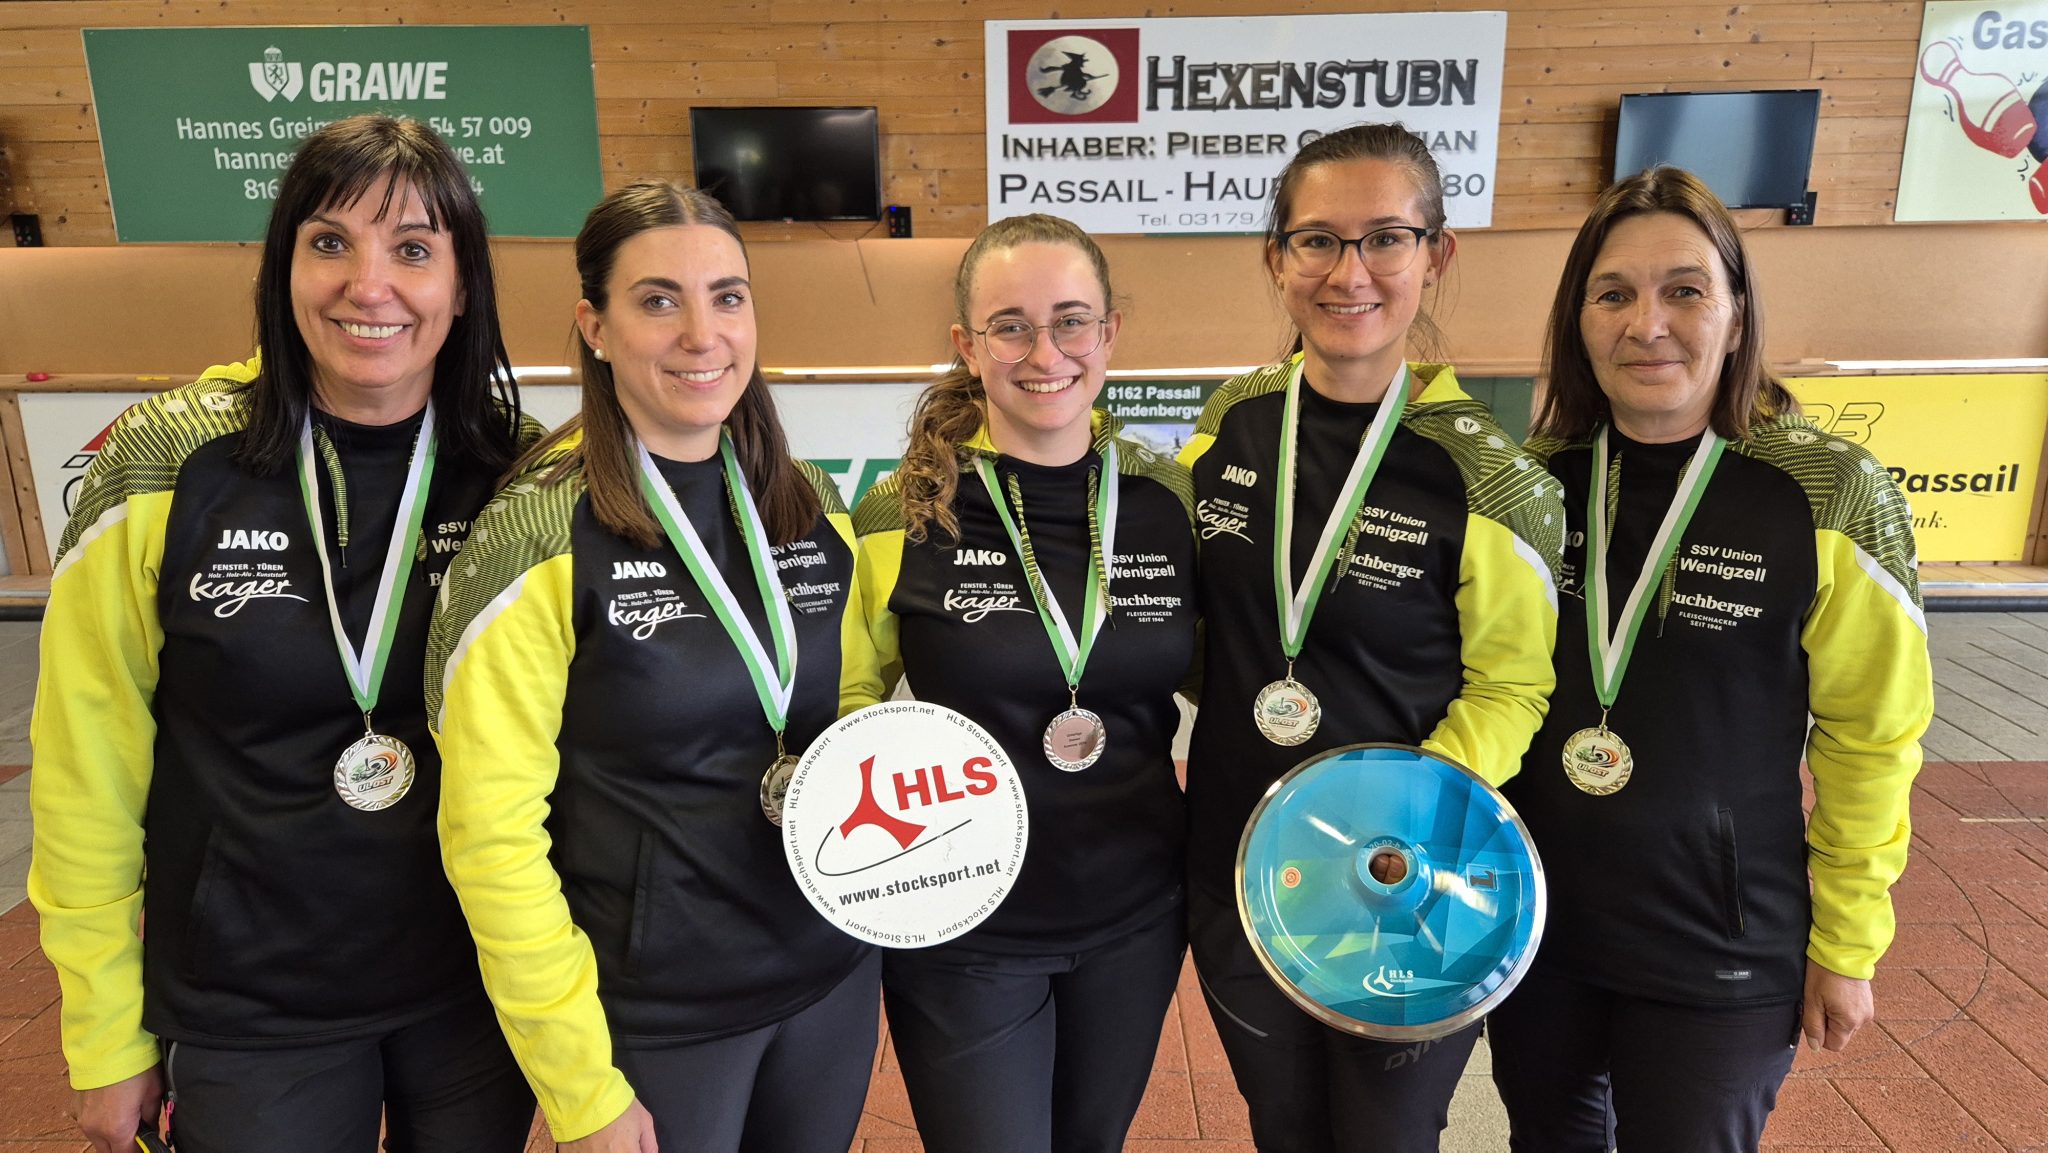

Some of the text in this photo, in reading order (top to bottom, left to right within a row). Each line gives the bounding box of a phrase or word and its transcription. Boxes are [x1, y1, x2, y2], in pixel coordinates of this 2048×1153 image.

[309, 61, 448, 102] GRAWE
[1145, 55, 1479, 112] HEXENSTUBN
[176, 117, 263, 140] Hannes
[429, 117, 456, 138] 54
[461, 117, 484, 138] 57
[489, 117, 532, 139] 009
[1001, 133, 1156, 159] INHABER:
[1167, 131, 1287, 156] PIEBER
[1000, 173, 1158, 204] PASSAIL
[1137, 213, 1172, 227] Tel.
[1107, 385, 1201, 400] 8162 Passail
[1221, 464, 1257, 488] JAKO
[437, 520, 467, 535] SSV
[1363, 506, 1427, 529] SSV Union
[217, 529, 289, 551] JAKO
[787, 540, 818, 552] Union
[953, 548, 1007, 566] JAKO
[1111, 553, 1168, 564] SSV Union
[1690, 544, 1763, 563] SSV Union
[212, 562, 284, 572] FENSTER TÜREN
[611, 560, 667, 580] JAKO
[1680, 557, 1767, 583] Wenigzell
[960, 582, 988, 590] FENSTER
[1358, 579, 1372, 588] SEIT
[1679, 611, 1738, 627] FLEISCHHACKER
[1690, 620, 1705, 628] SEIT
[838, 705, 936, 733] www.stocksport.net
[946, 712, 1007, 768] HLS Stocksport
[789, 736, 832, 810] HLS Stocksport
[892, 756, 998, 812] HLS
[1005, 777, 1025, 877] www.stocksport.net
[838, 858, 1002, 907] www.stocksport.net
[937, 886, 1005, 938] HLS Stocksport
[845, 918, 926, 944] HLS Stocksport
[1388, 969, 1414, 979] HLS
